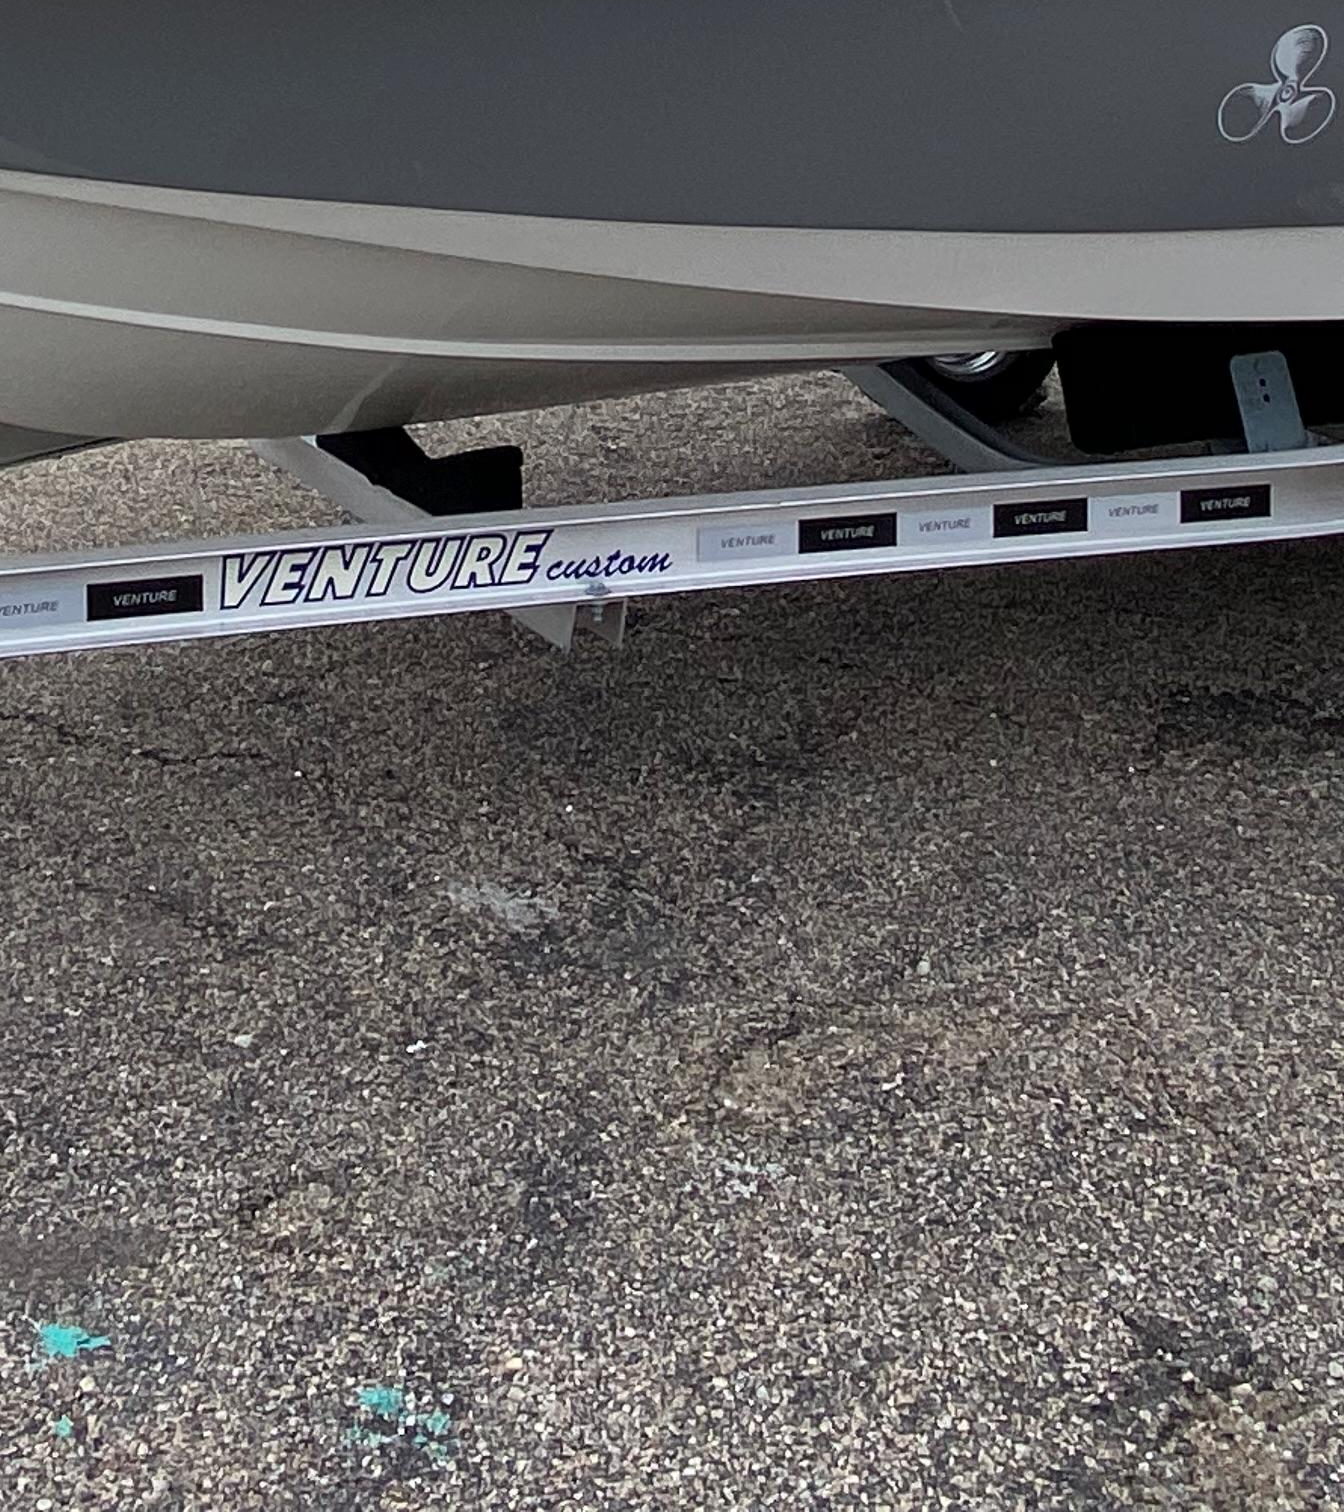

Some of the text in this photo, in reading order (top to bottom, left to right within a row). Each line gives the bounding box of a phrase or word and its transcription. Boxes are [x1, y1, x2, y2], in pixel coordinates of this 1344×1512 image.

[1108, 504, 1159, 518] VENTURE
[1199, 497, 1251, 511] VENTURE
[918, 518, 970, 532] VENTURE
[1014, 510, 1067, 525] VENTURE
[821, 525, 876, 541] VENTURE
[721, 534, 776, 549] VENTURE
[220, 529, 673, 609] VENTURE custom
[113, 590, 177, 608] VENTURE
